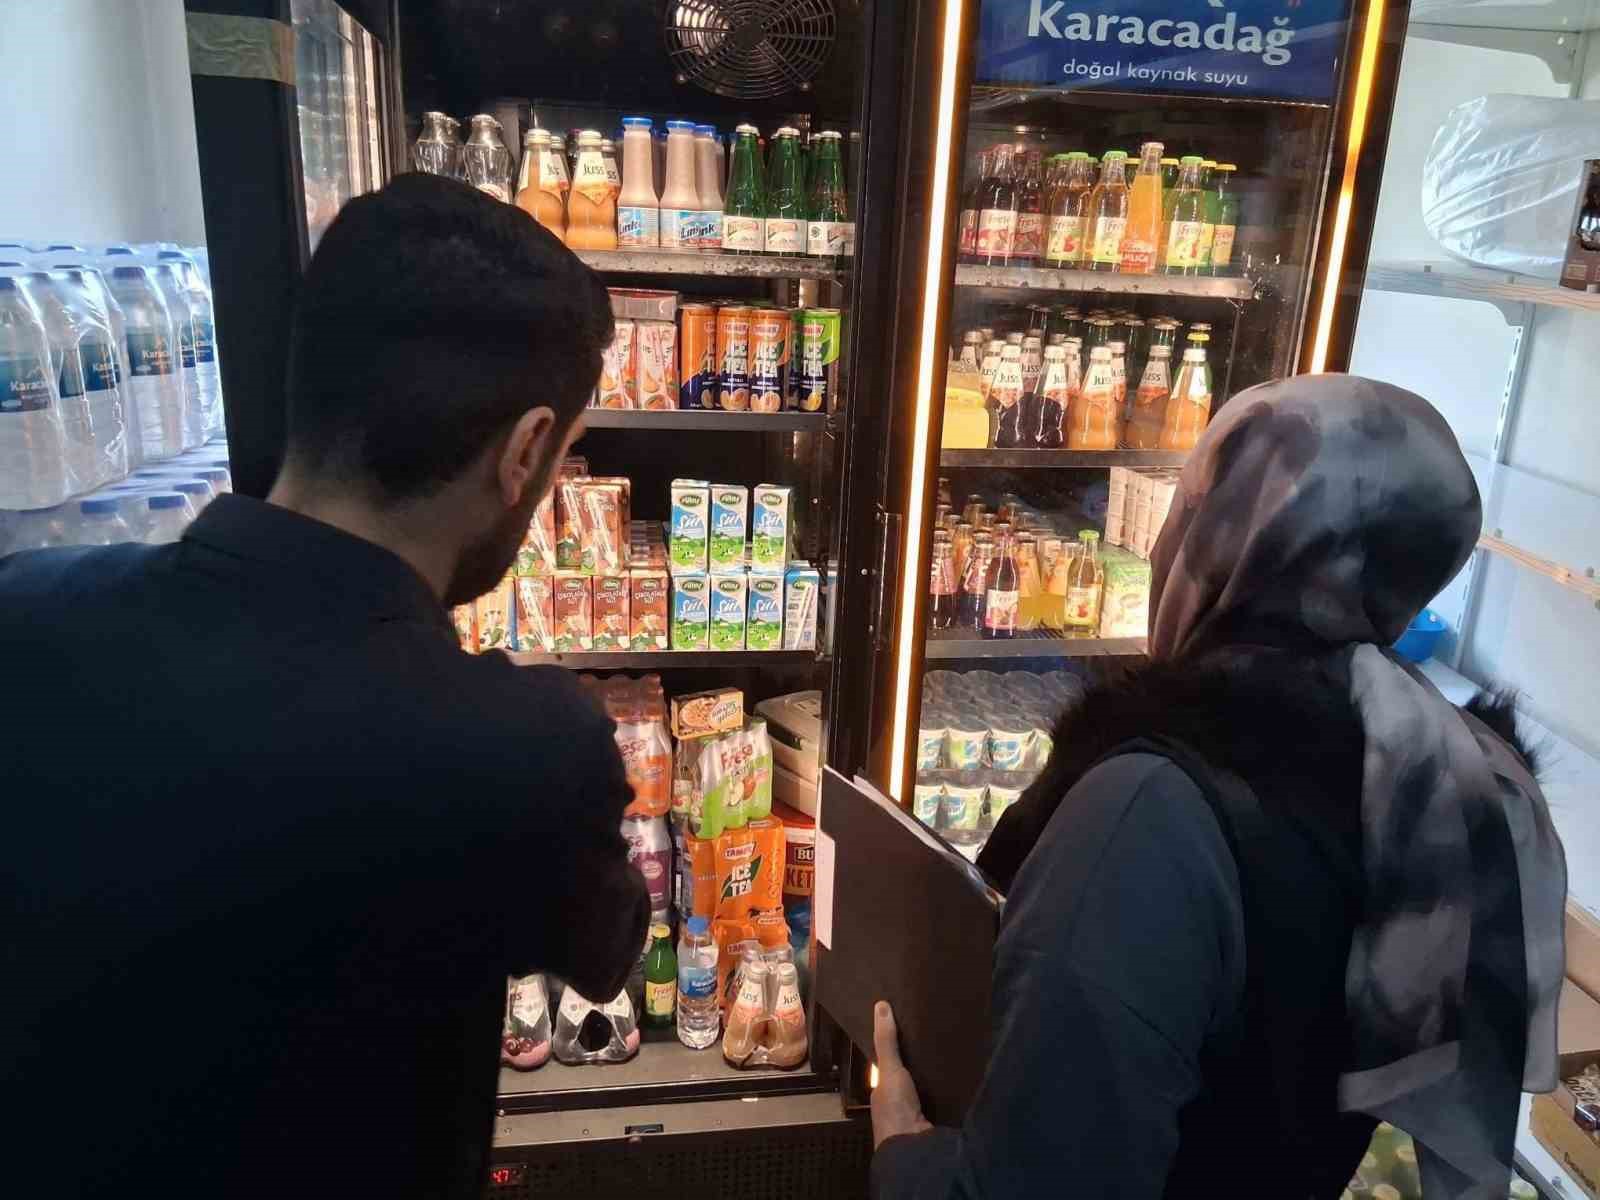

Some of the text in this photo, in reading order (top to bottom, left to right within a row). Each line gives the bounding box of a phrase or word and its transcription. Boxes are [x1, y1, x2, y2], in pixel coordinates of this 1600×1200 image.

[1027, 0, 1295, 67] Karacadağ
[1063, 59, 1249, 87] doğal kaynak suyu
[731, 862, 752, 882] ICE
[730, 879, 752, 897] TEA
